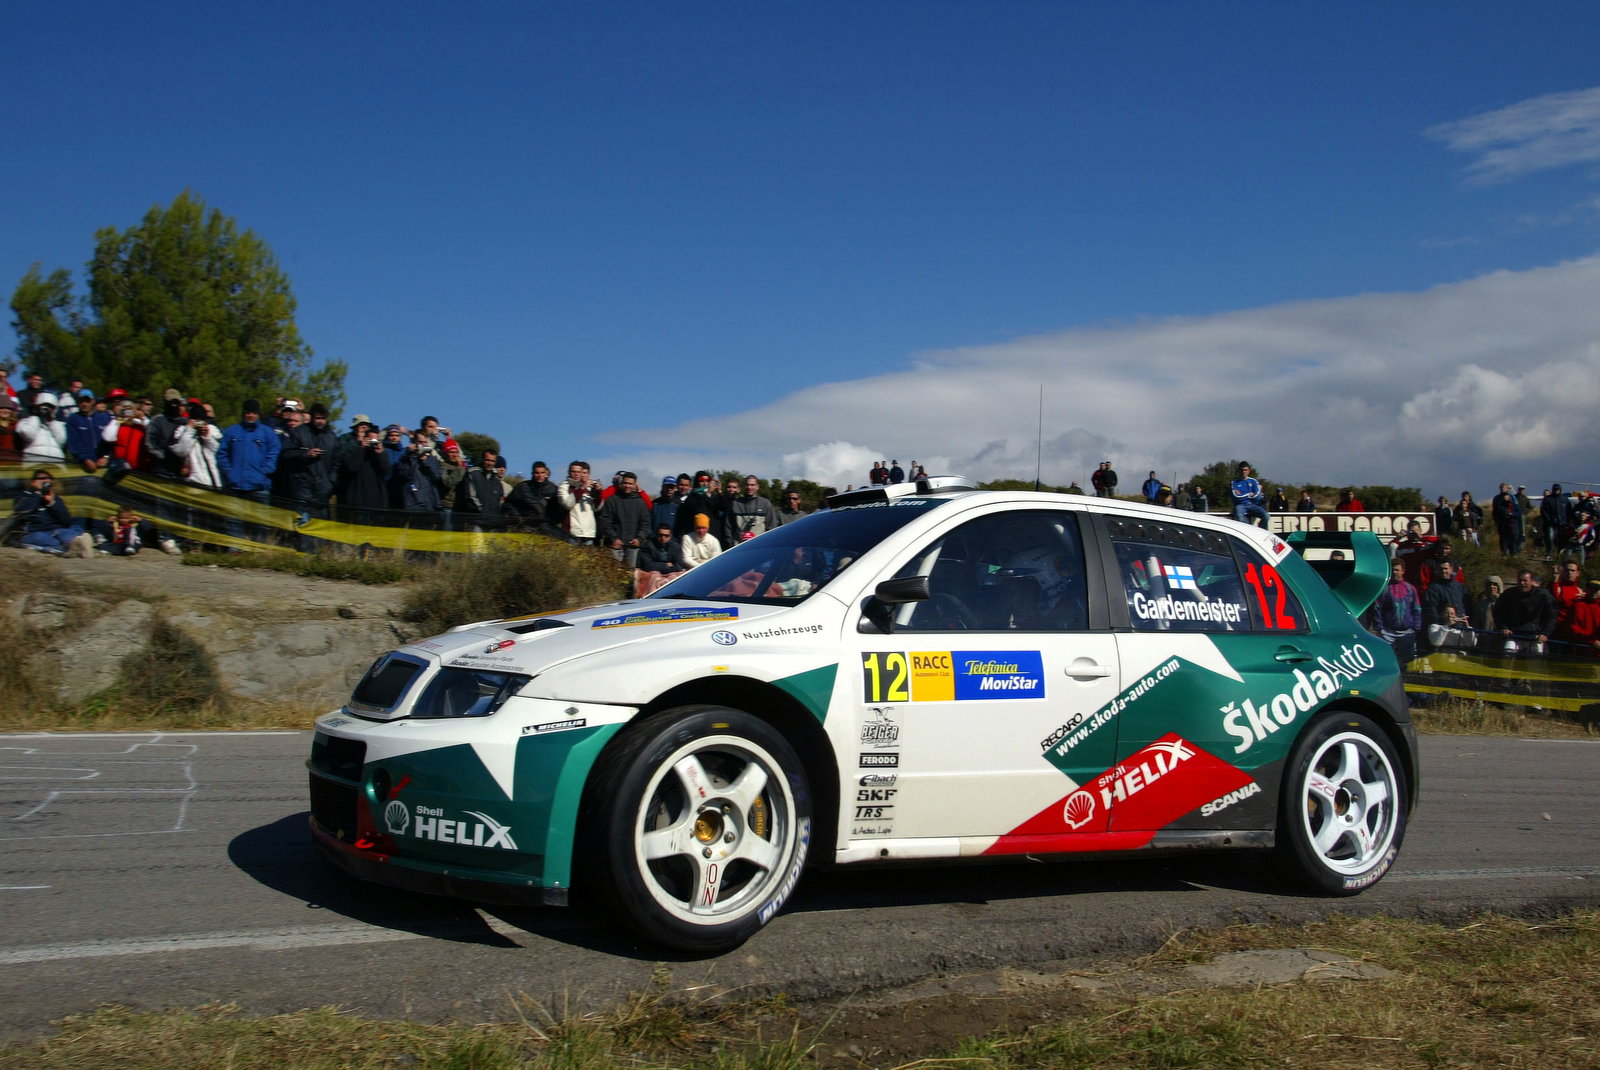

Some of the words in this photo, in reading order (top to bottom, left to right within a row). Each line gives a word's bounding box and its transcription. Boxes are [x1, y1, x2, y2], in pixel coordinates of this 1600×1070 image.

[1133, 592, 1241, 622] Gardemeister
[1245, 563, 1296, 629] 12
[743, 624, 823, 640] Nutzfahrzeuge
[913, 656, 949, 669] RACC
[864, 652, 908, 702] 12
[979, 676, 1038, 691] MoviStar
[1055, 659, 1181, 757] www.skoda-auto.com
[1040, 712, 1083, 751] RECARO
[861, 756, 897, 765] FERODO
[859, 774, 897, 787] Eibach
[1098, 738, 1197, 811] HELIX
[1098, 765, 1126, 788] Shell
[857, 789, 898, 801] SKF
[1200, 782, 1262, 817] SCANIA
[416, 805, 444, 817] Shell
[855, 805, 894, 818] TRS
[414, 810, 519, 850] HELIX
